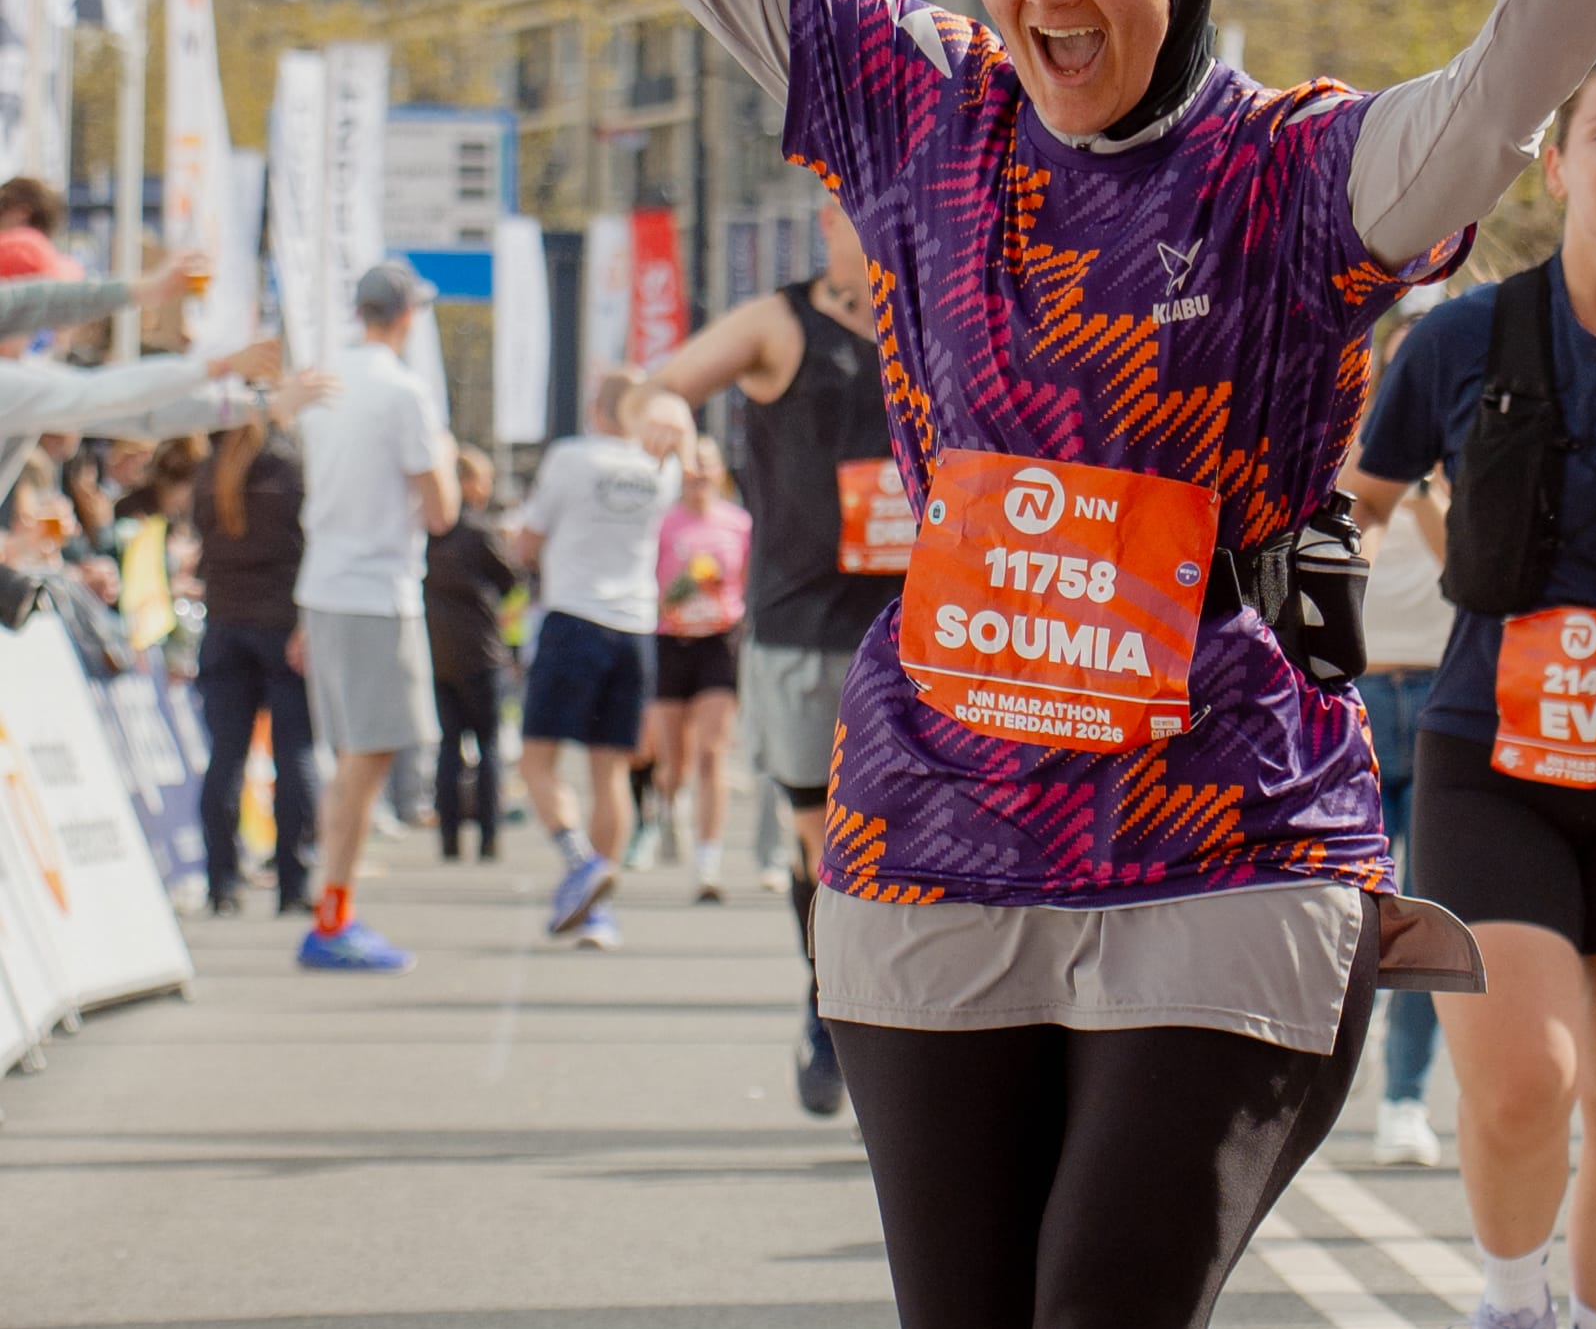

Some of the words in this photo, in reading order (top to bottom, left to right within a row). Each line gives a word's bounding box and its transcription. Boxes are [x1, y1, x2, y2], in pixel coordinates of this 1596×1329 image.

[1152, 294, 1211, 325] KLABU
[1074, 495, 1118, 522] NN
[985, 546, 1117, 604] 11758
[934, 603, 1152, 677] SOUMIA
[954, 703, 1073, 737] ROTTERDAM
[1075, 722, 1124, 743] 2026
[967, 689, 995, 709] NN
[998, 693, 1111, 725] MARATHON
